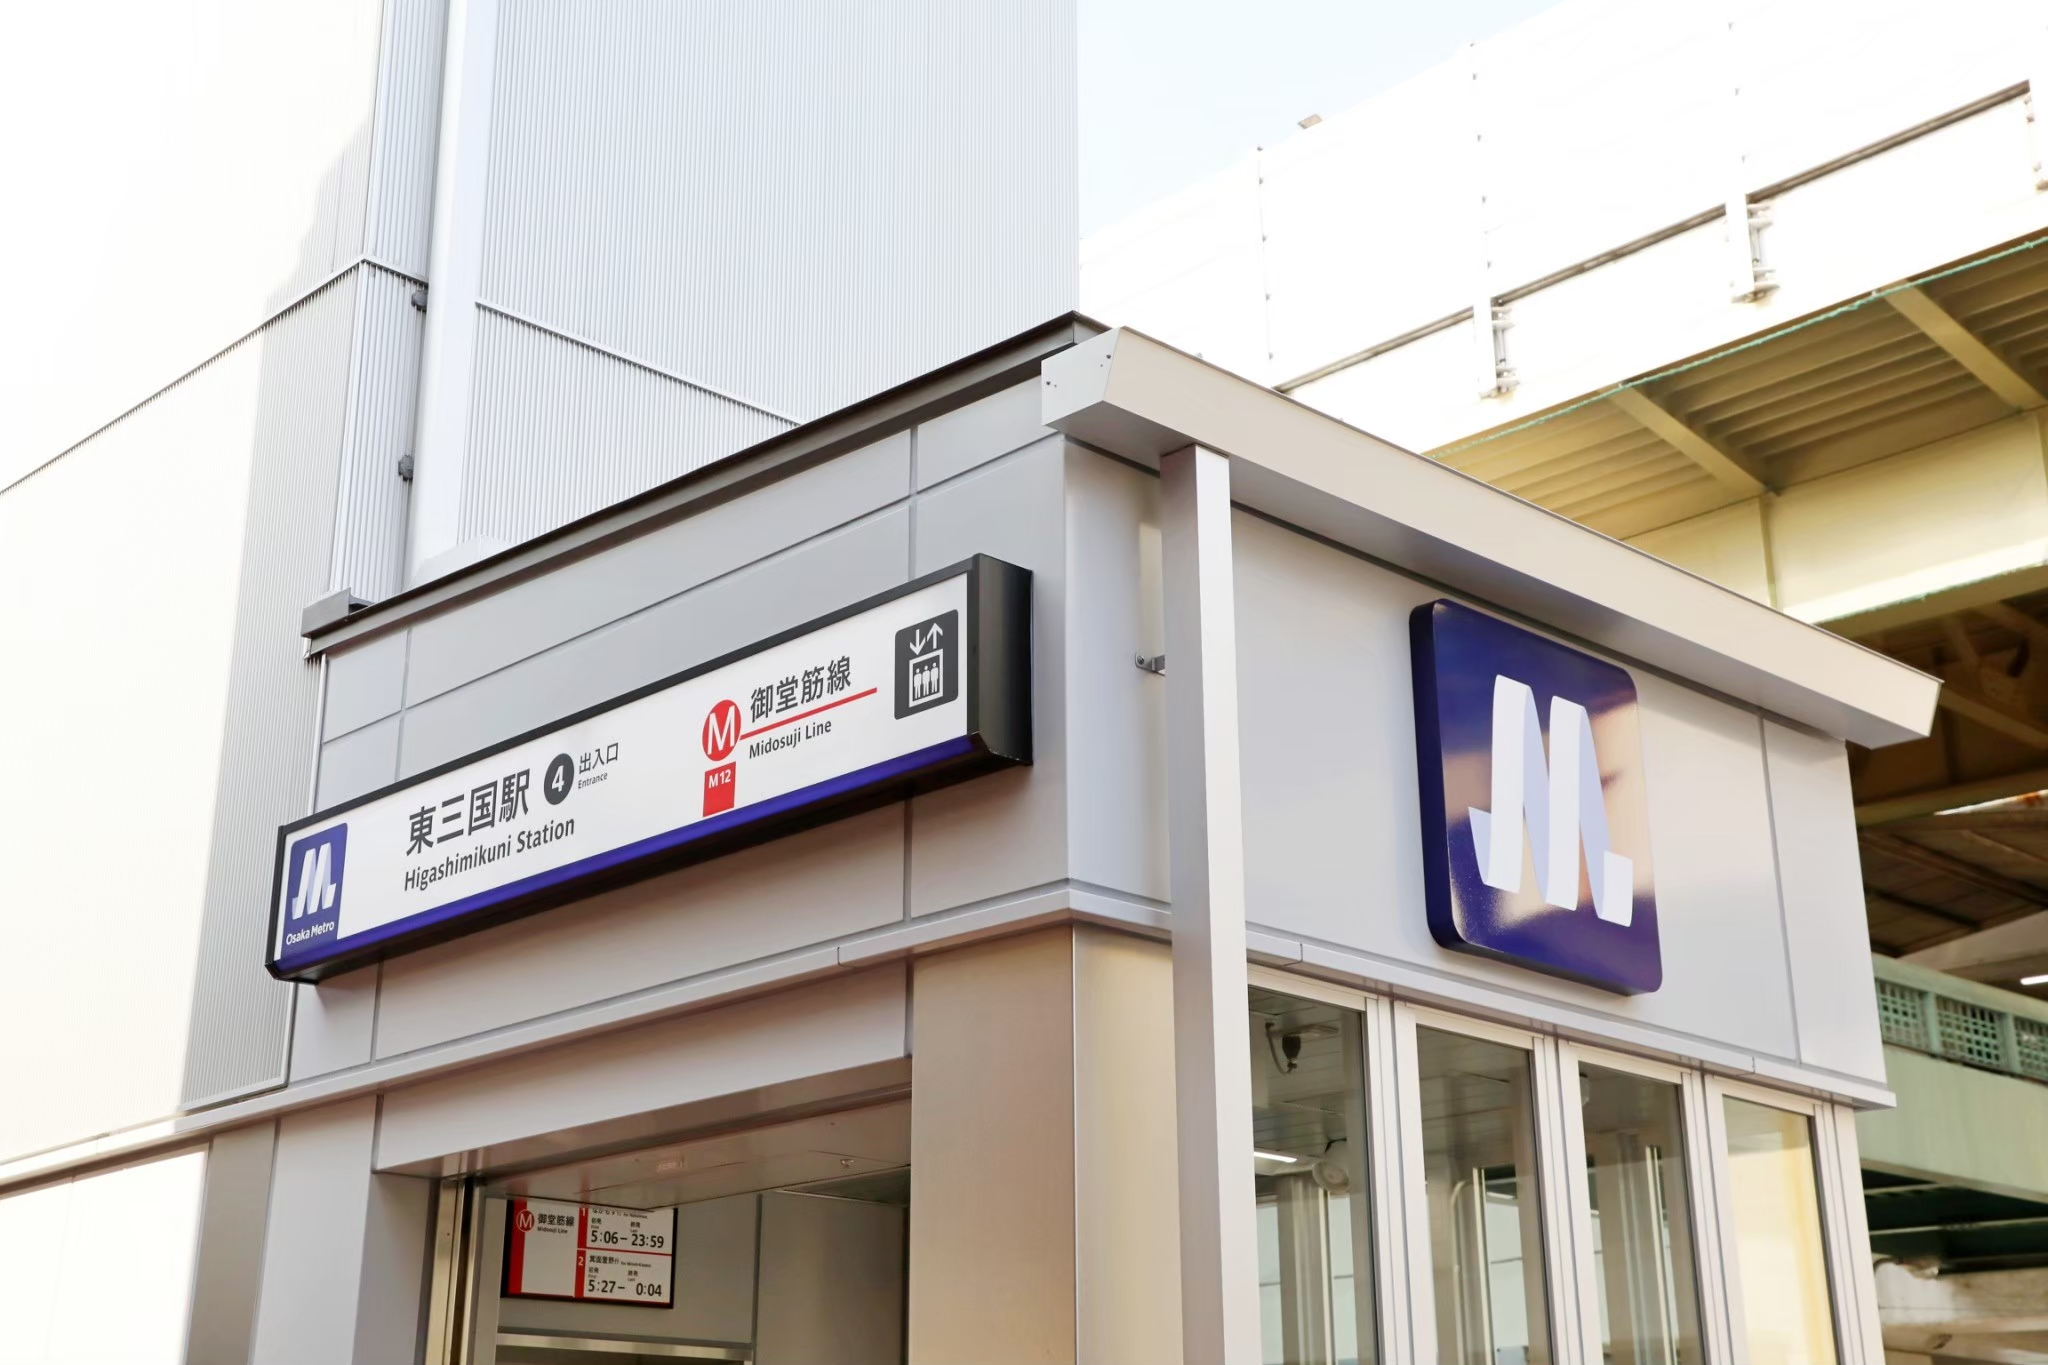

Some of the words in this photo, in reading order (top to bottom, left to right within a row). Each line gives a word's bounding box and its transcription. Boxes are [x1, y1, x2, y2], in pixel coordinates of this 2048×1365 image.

[750, 655, 851, 723] 御堂筋線
[707, 705, 735, 755] M
[749, 727, 801, 760] Midosuji
[805, 720, 832, 740] Line
[578, 742, 619, 774] 出入口
[551, 765, 565, 792] 4
[578, 772, 608, 789] Entrance
[708, 769, 732, 789] M12
[406, 768, 531, 856] 東三国駅
[404, 835, 512, 892] Higashimikuni
[517, 818, 575, 853] Station
[286, 928, 310, 945] Osaka
[311, 921, 335, 936] Metro
[519, 1213, 532, 1229] M
[538, 1213, 575, 1226] 御堂筋線
[631, 1233, 664, 1248] 23:59
[578, 1256, 584, 1266] 2
[636, 1282, 662, 1296] 0:04
